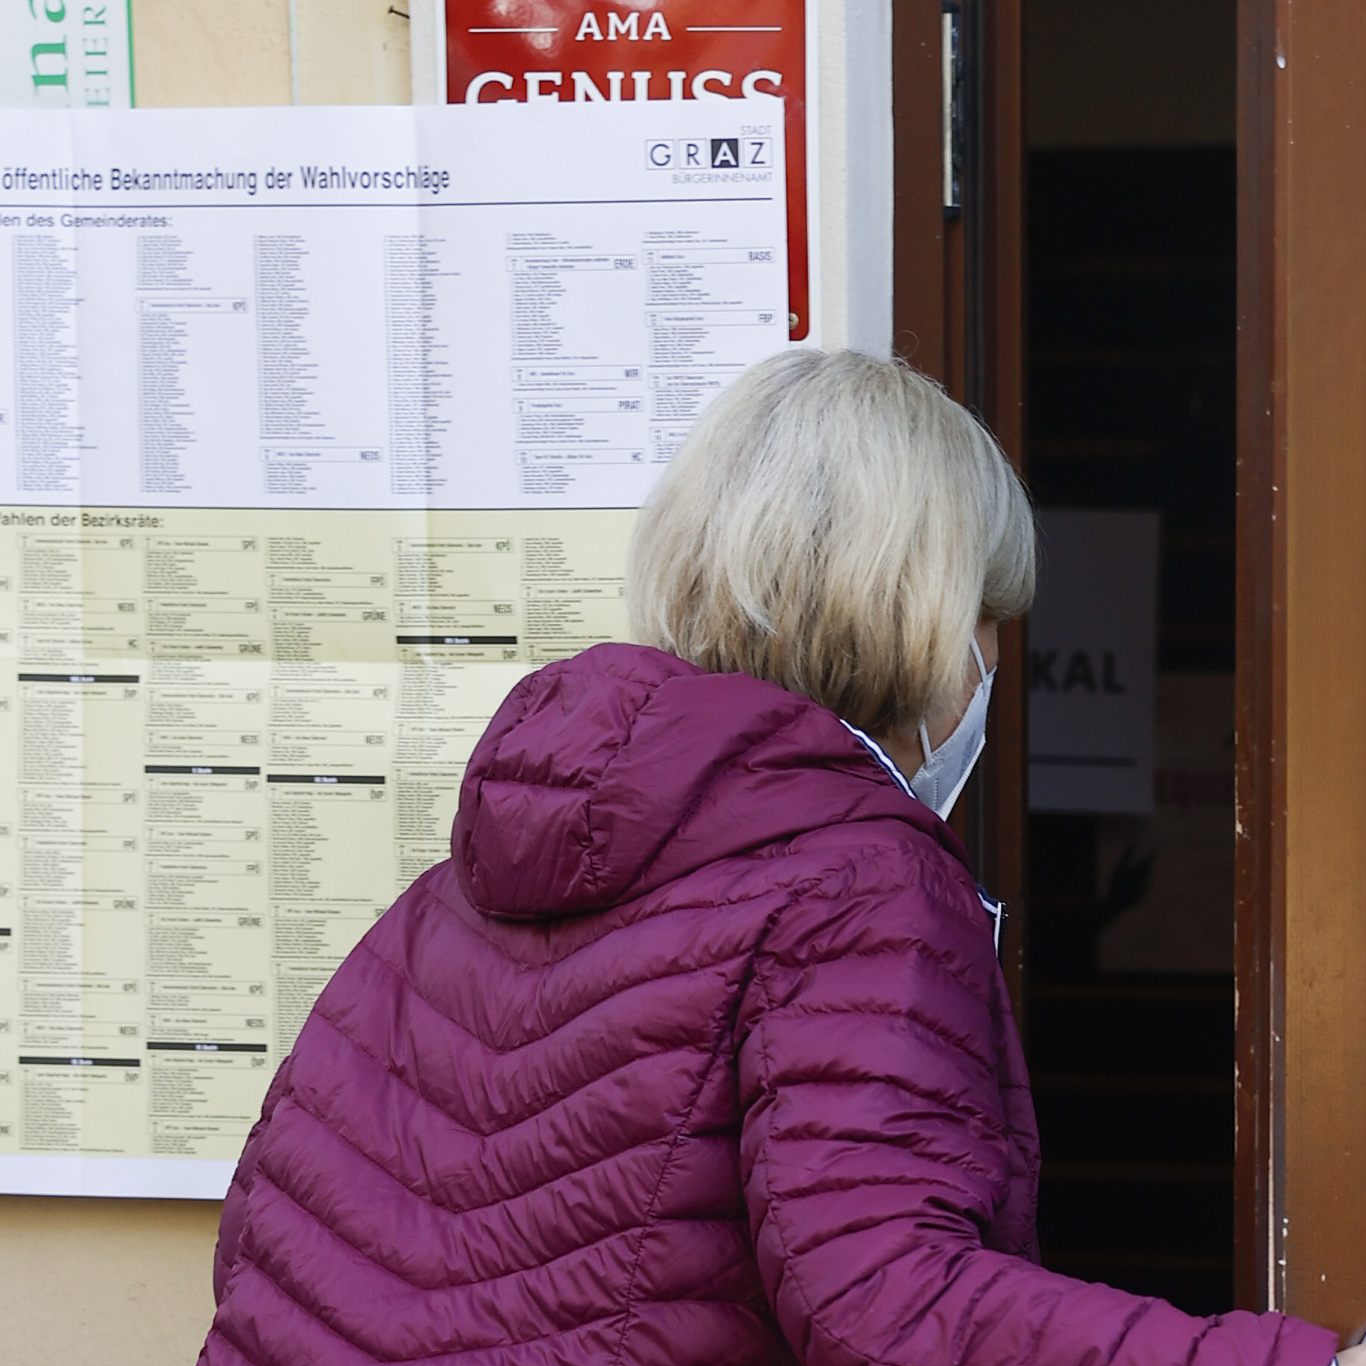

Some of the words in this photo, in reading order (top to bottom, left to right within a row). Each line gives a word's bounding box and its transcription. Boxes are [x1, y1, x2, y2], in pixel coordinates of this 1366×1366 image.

[575, 12, 672, 41] AMA
[740, 124, 772, 136] STADT
[650, 141, 768, 168] GRAZ
[2, 167, 102, 190] öffentliche
[111, 168, 257, 195] Bekanntmachung
[265, 170, 293, 190] der
[301, 165, 450, 195] Wahlvorschläge
[27, 213, 55, 228] des
[60, 213, 173, 228] Gemeinderates:
[0, 512, 45, 526] ahlen
[51, 513, 77, 527] der
[82, 512, 164, 528] Bezirksräte:
